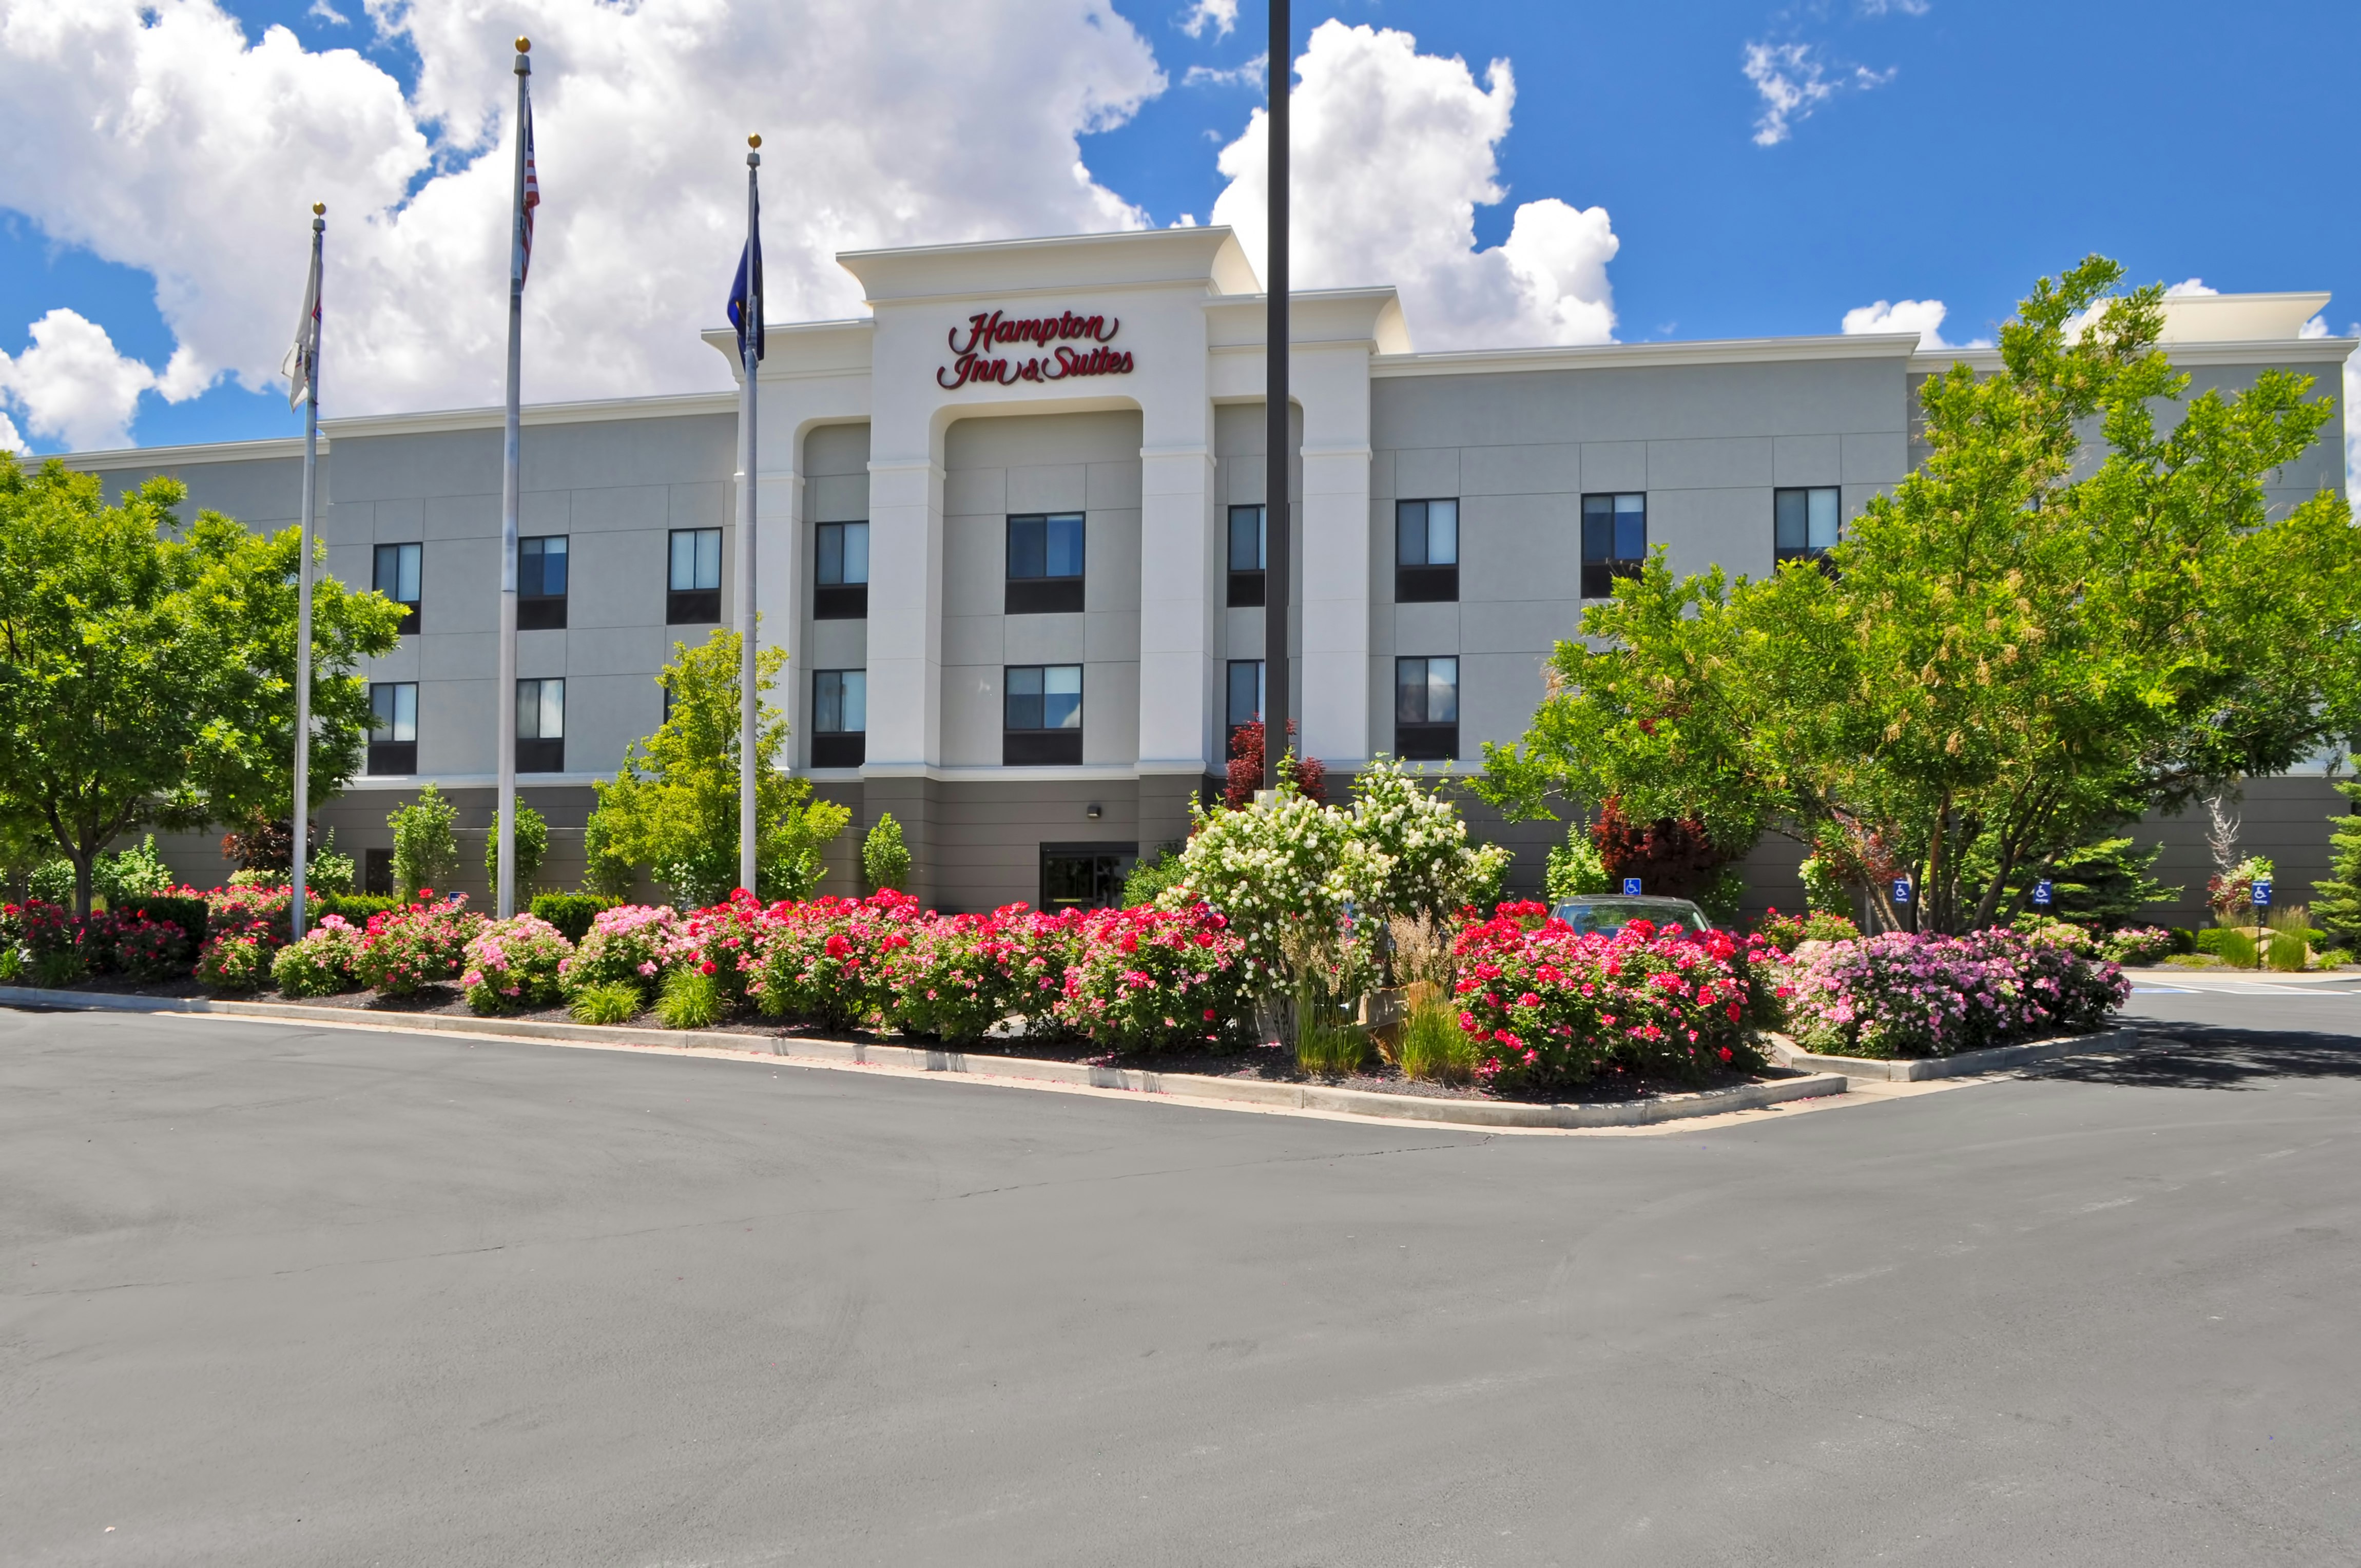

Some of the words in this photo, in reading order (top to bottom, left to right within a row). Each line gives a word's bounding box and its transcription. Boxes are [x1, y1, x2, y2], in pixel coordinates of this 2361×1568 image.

[948, 309, 1119, 354] Hampton
[936, 353, 1022, 390] Inn
[1021, 358, 1045, 383] &
[1041, 345, 1134, 379] Suites
